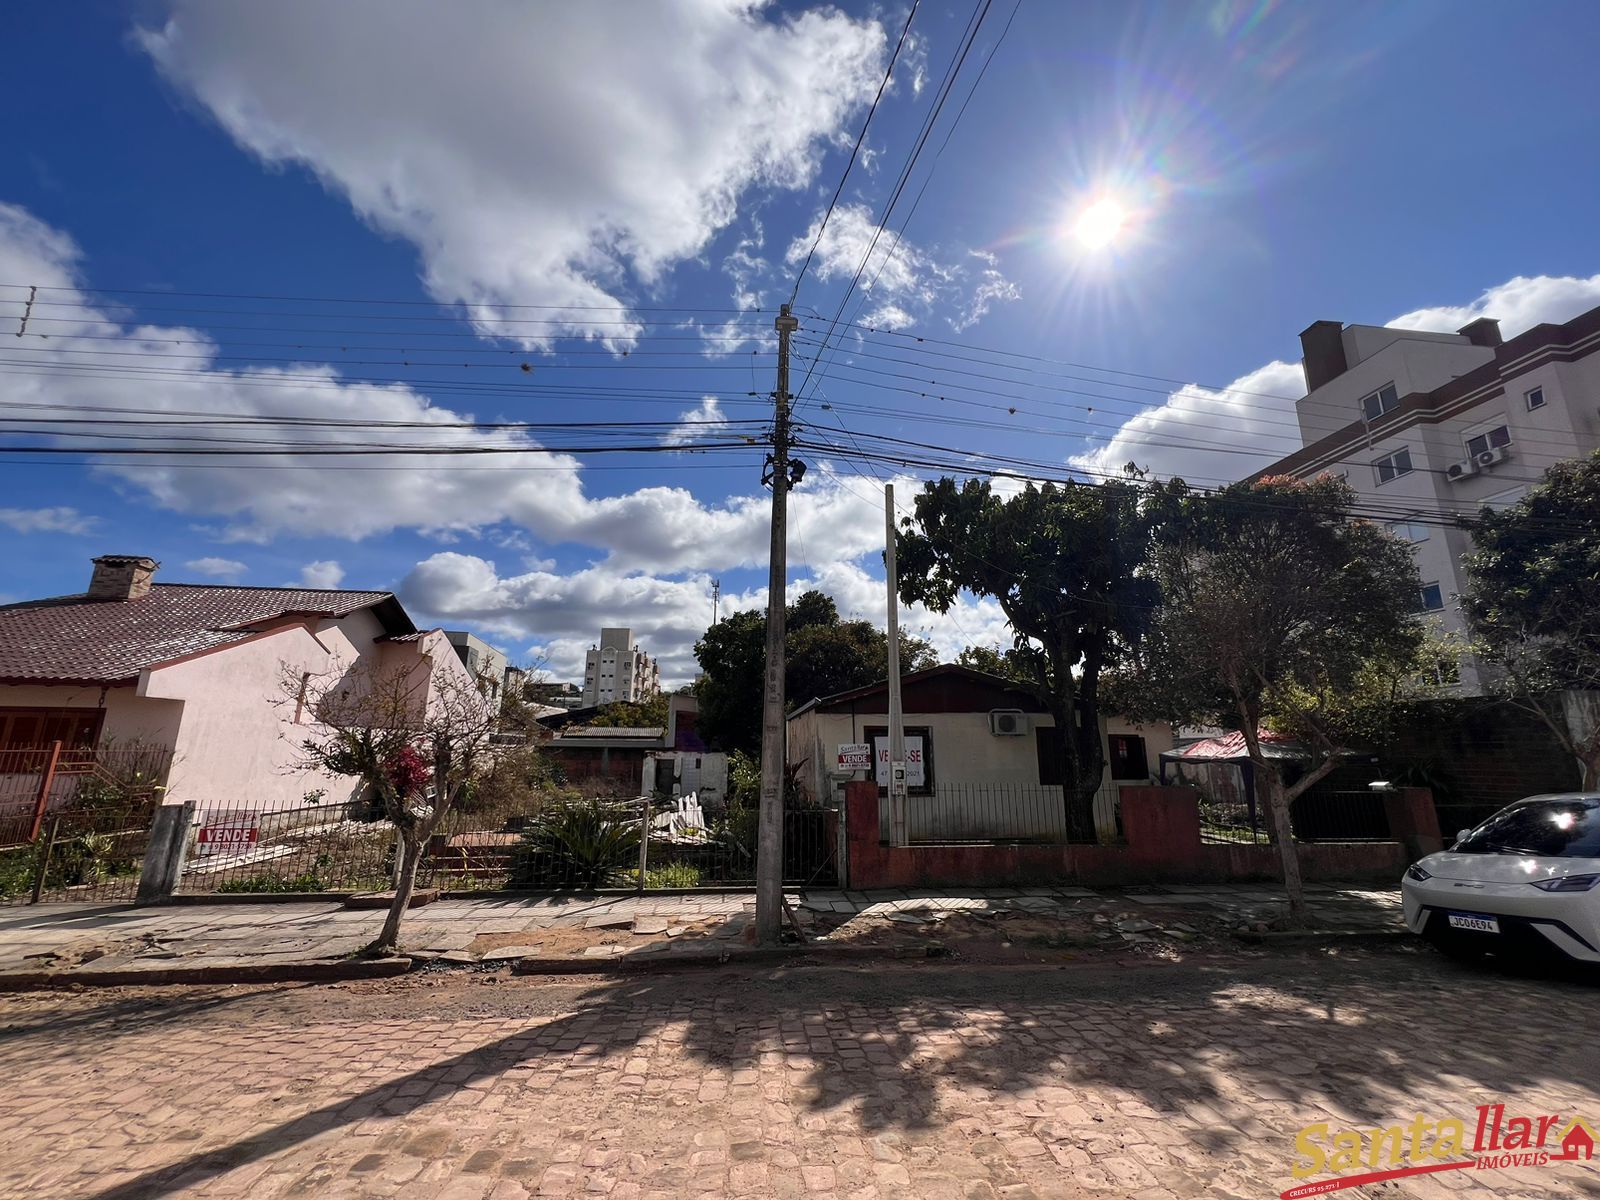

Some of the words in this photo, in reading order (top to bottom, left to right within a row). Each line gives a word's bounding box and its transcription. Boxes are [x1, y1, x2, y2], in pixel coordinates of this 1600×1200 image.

[842, 755, 867, 763] VENDE
[879, 749, 921, 763] VE-SE
[207, 830, 250, 841] VENDE
